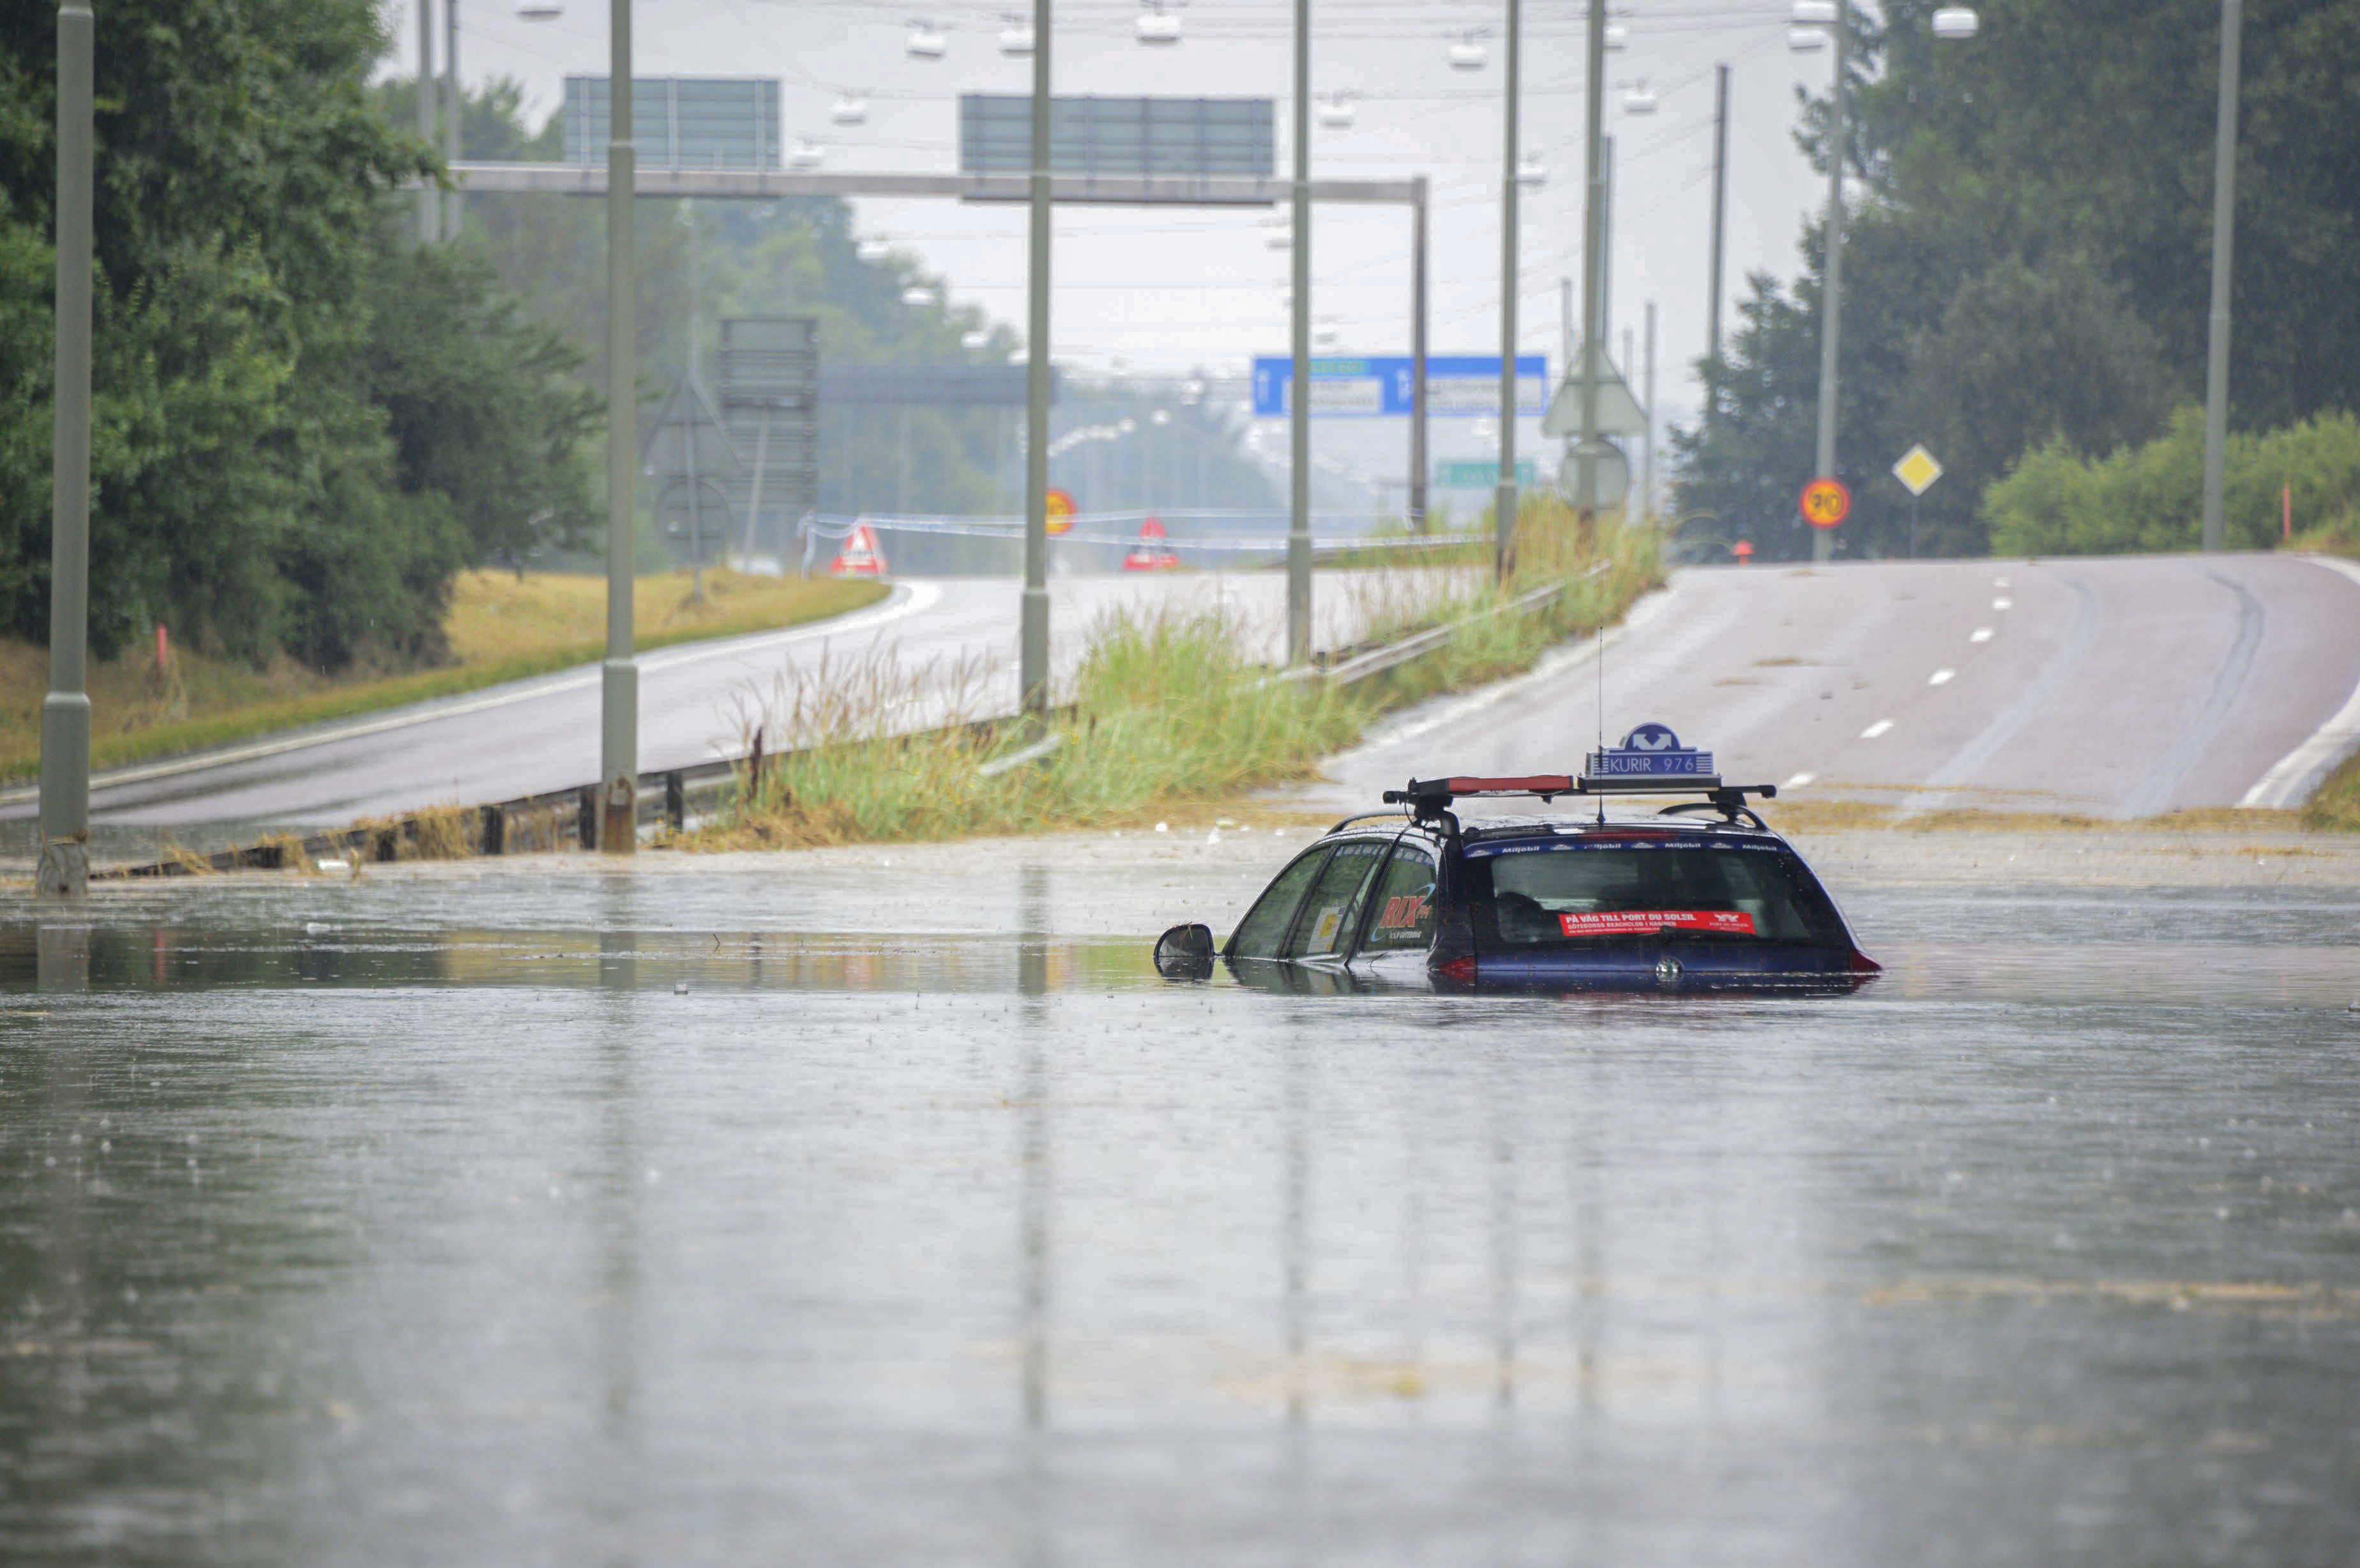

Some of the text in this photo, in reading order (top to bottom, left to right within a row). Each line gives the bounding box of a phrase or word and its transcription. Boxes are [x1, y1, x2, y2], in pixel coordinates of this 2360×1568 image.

[1610, 758, 1694, 772] KURIR 976
[1379, 896, 1433, 928] RIX FM
